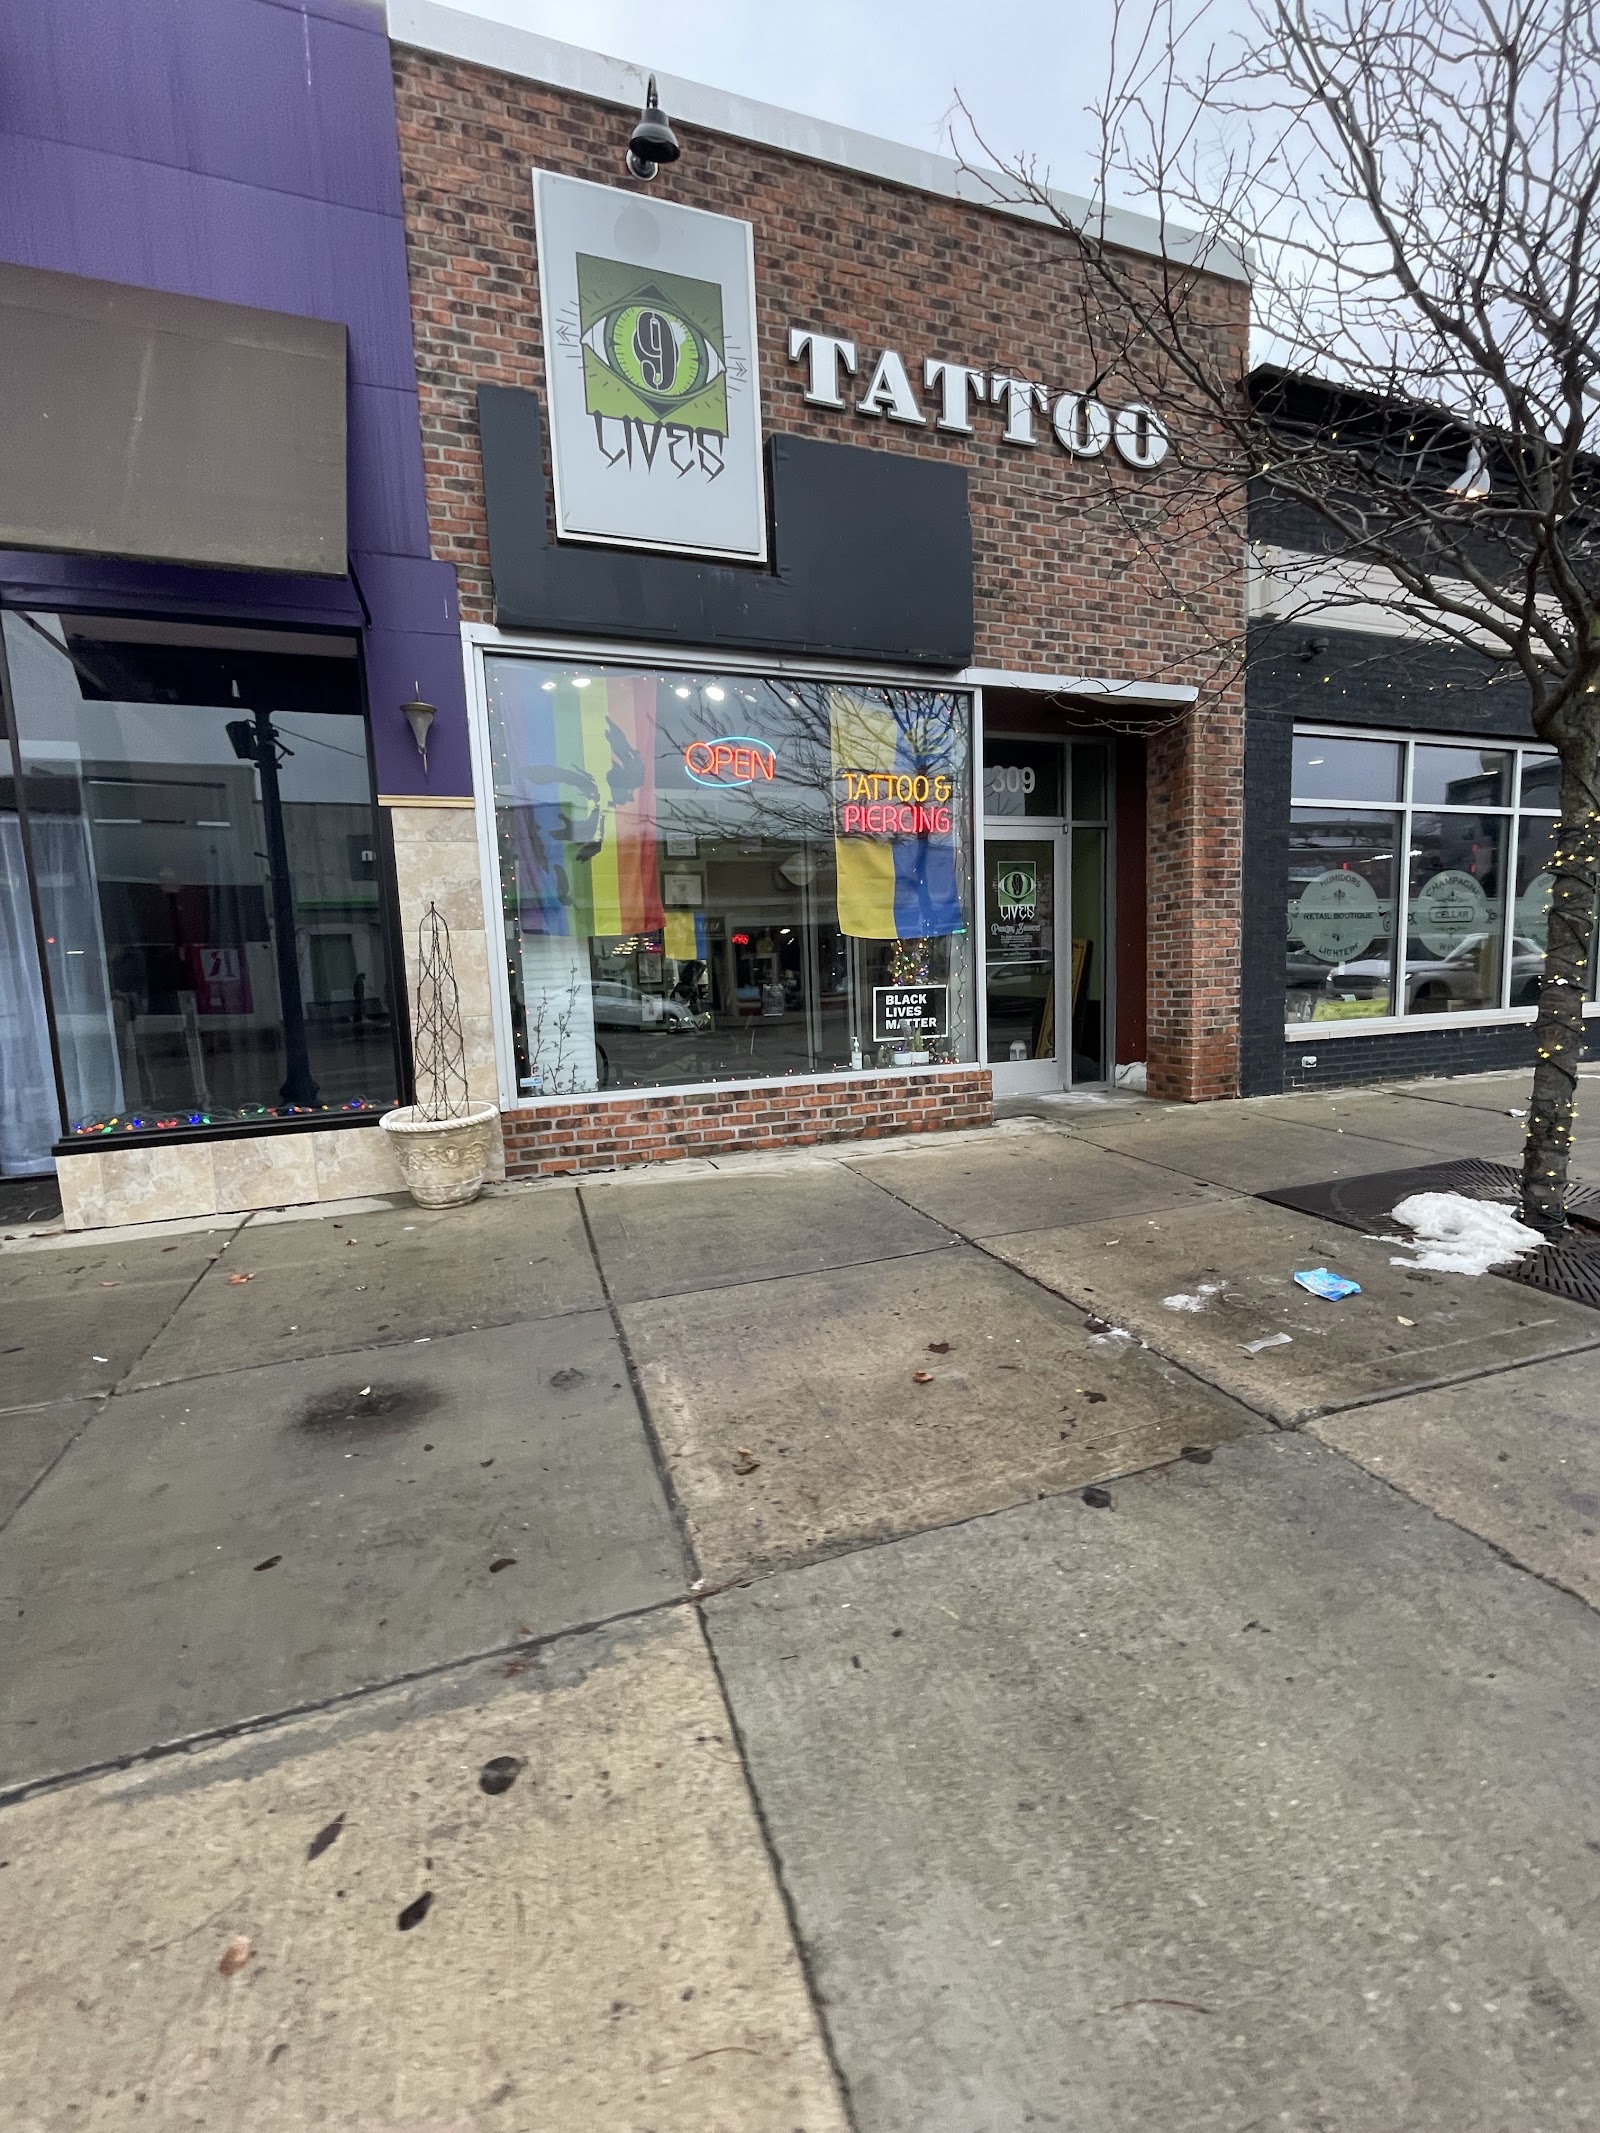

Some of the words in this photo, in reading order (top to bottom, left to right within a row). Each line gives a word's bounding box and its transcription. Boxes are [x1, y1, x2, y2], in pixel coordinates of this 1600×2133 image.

[635, 308, 679, 393] 9
[788, 326, 1170, 469] TATTOO
[593, 410, 725, 485] LIVES
[684, 741, 775, 781] OPEN
[841, 773, 929, 802] TATTOO
[933, 775, 952, 802] &
[991, 765, 1036, 794] 309
[843, 804, 951, 833] PIERCING
[1320, 874, 1362, 888] HUMIDORS
[999, 904, 1035, 921] LIVES
[1303, 912, 1332, 920] RETAIL
[1333, 911, 1374, 920] BOUTIQUE
[1435, 910, 1469, 919] CELLAR
[885, 994, 927, 1006] BLACK
[885, 1006, 922, 1018] LIVES
